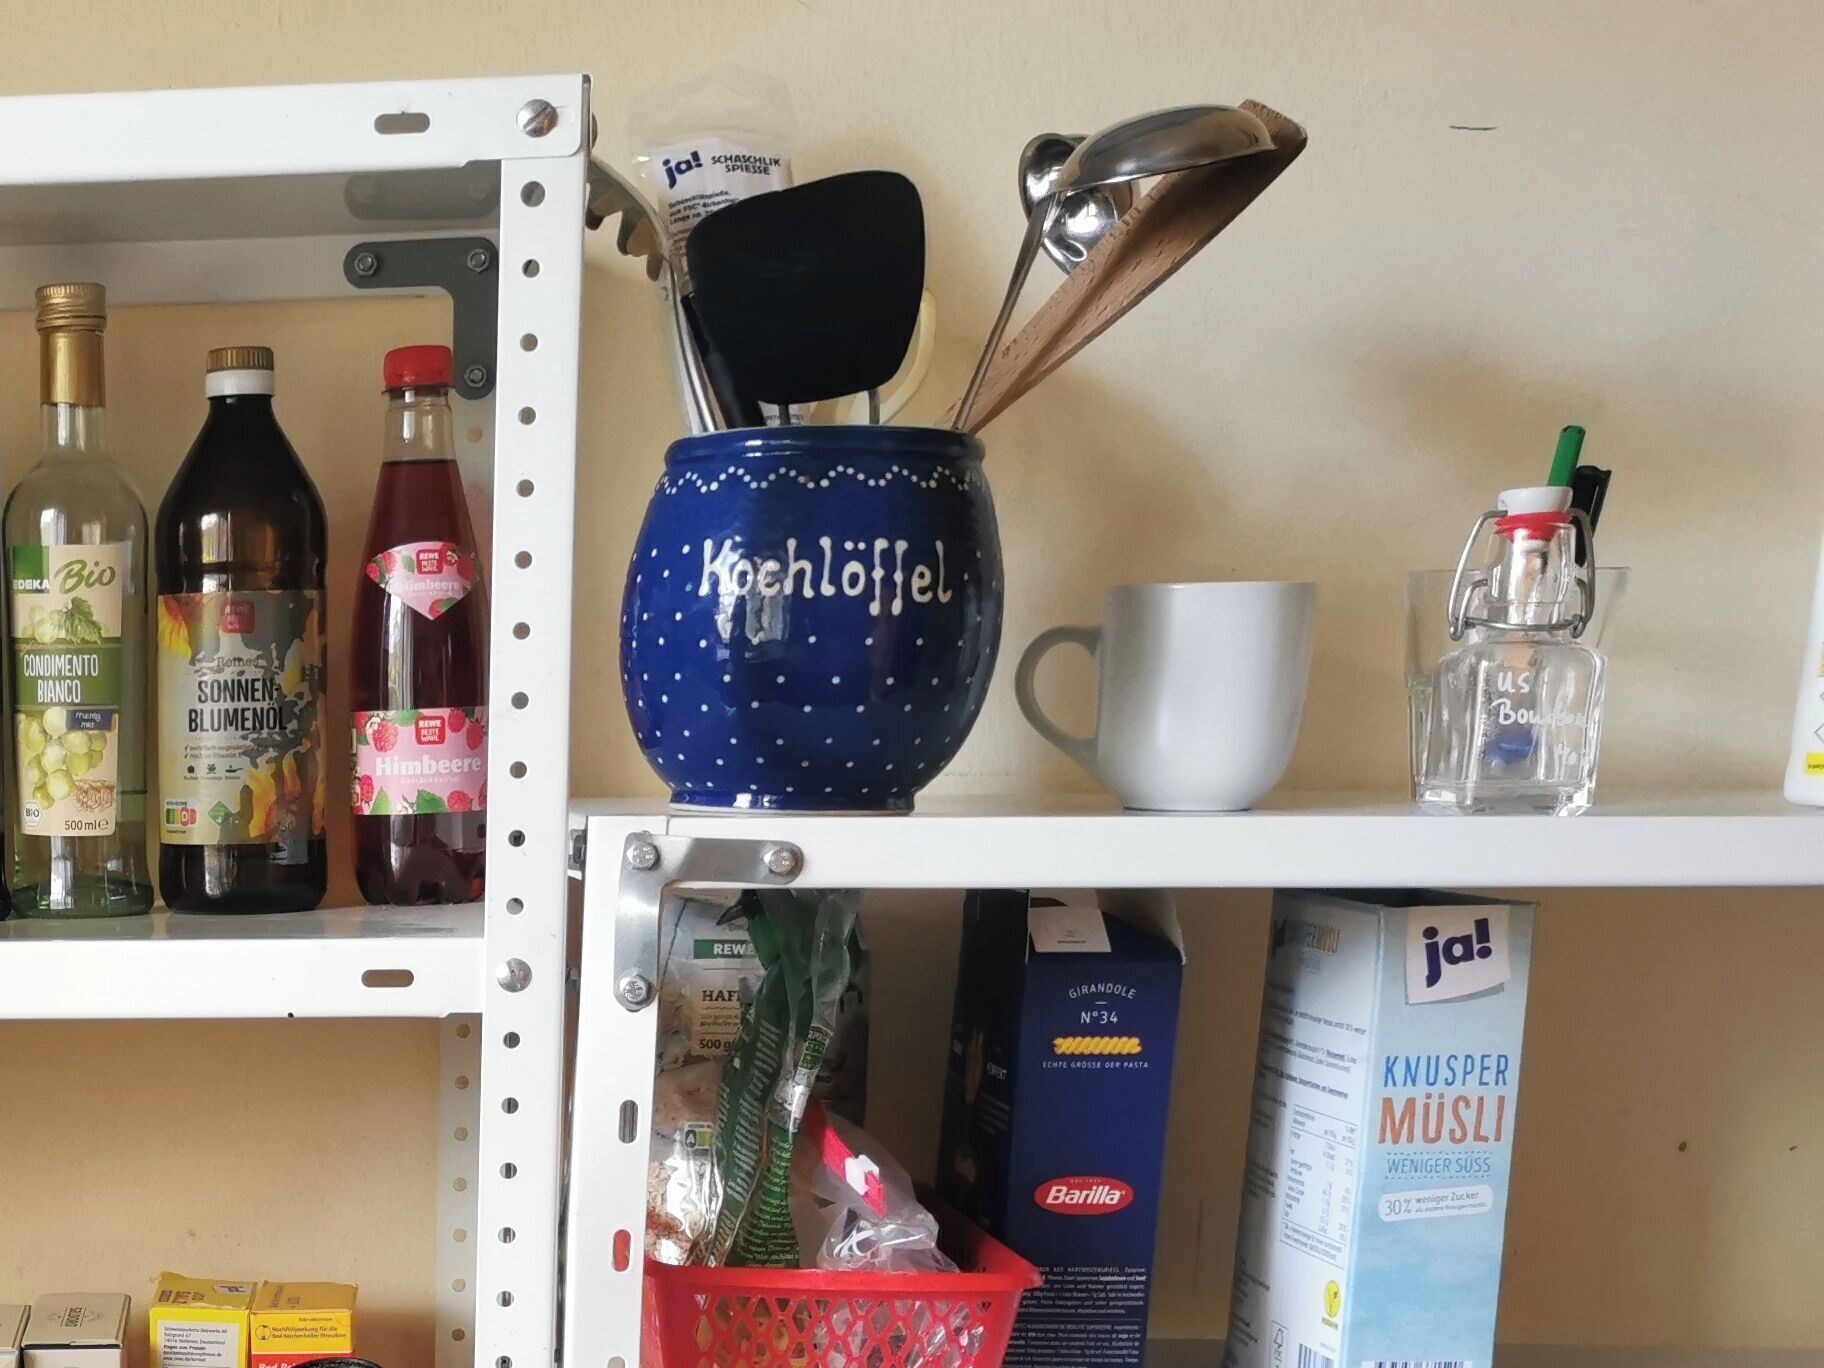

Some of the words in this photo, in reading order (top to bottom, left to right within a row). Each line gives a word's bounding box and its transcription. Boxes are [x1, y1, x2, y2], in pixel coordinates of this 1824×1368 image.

[662, 150, 703, 190] ja!
[711, 154, 782, 167] SCHASCHLIK
[725, 164, 771, 175] SPIESSE
[12, 579, 51, 590] EDEKA
[54, 559, 116, 594] Bio
[697, 537, 954, 616] Kochlöffel
[23, 655, 99, 677] CONDIMENTO
[37, 679, 81, 703] BIANCO
[197, 678, 280, 704] SONNEN-
[188, 702, 288, 733] BLUMENÖL
[418, 719, 441, 728] REWE
[375, 754, 482, 776] Himbeere
[1422, 918, 1493, 988] ja!
[1068, 982, 1137, 1000] GIRANDOLE
[698, 1038, 722, 1050] 500
[1042, 1061, 1068, 1069] ECHTE
[1104, 1061, 1120, 1069] DER
[1123, 1061, 1150, 1069] PASTA
[1383, 1054, 1509, 1087] KNUSPER
[1378, 1092, 1506, 1145] MÜSLI
[1386, 1157, 1452, 1174] WENIGER
[1455, 1155, 1491, 1174] SÜSS
[1045, 1185, 1121, 1205] Barilla
[1384, 1198, 1412, 1216] 30%
[1415, 1194, 1450, 1206] weniger
[1450, 1190, 1480, 1202] Zucker
